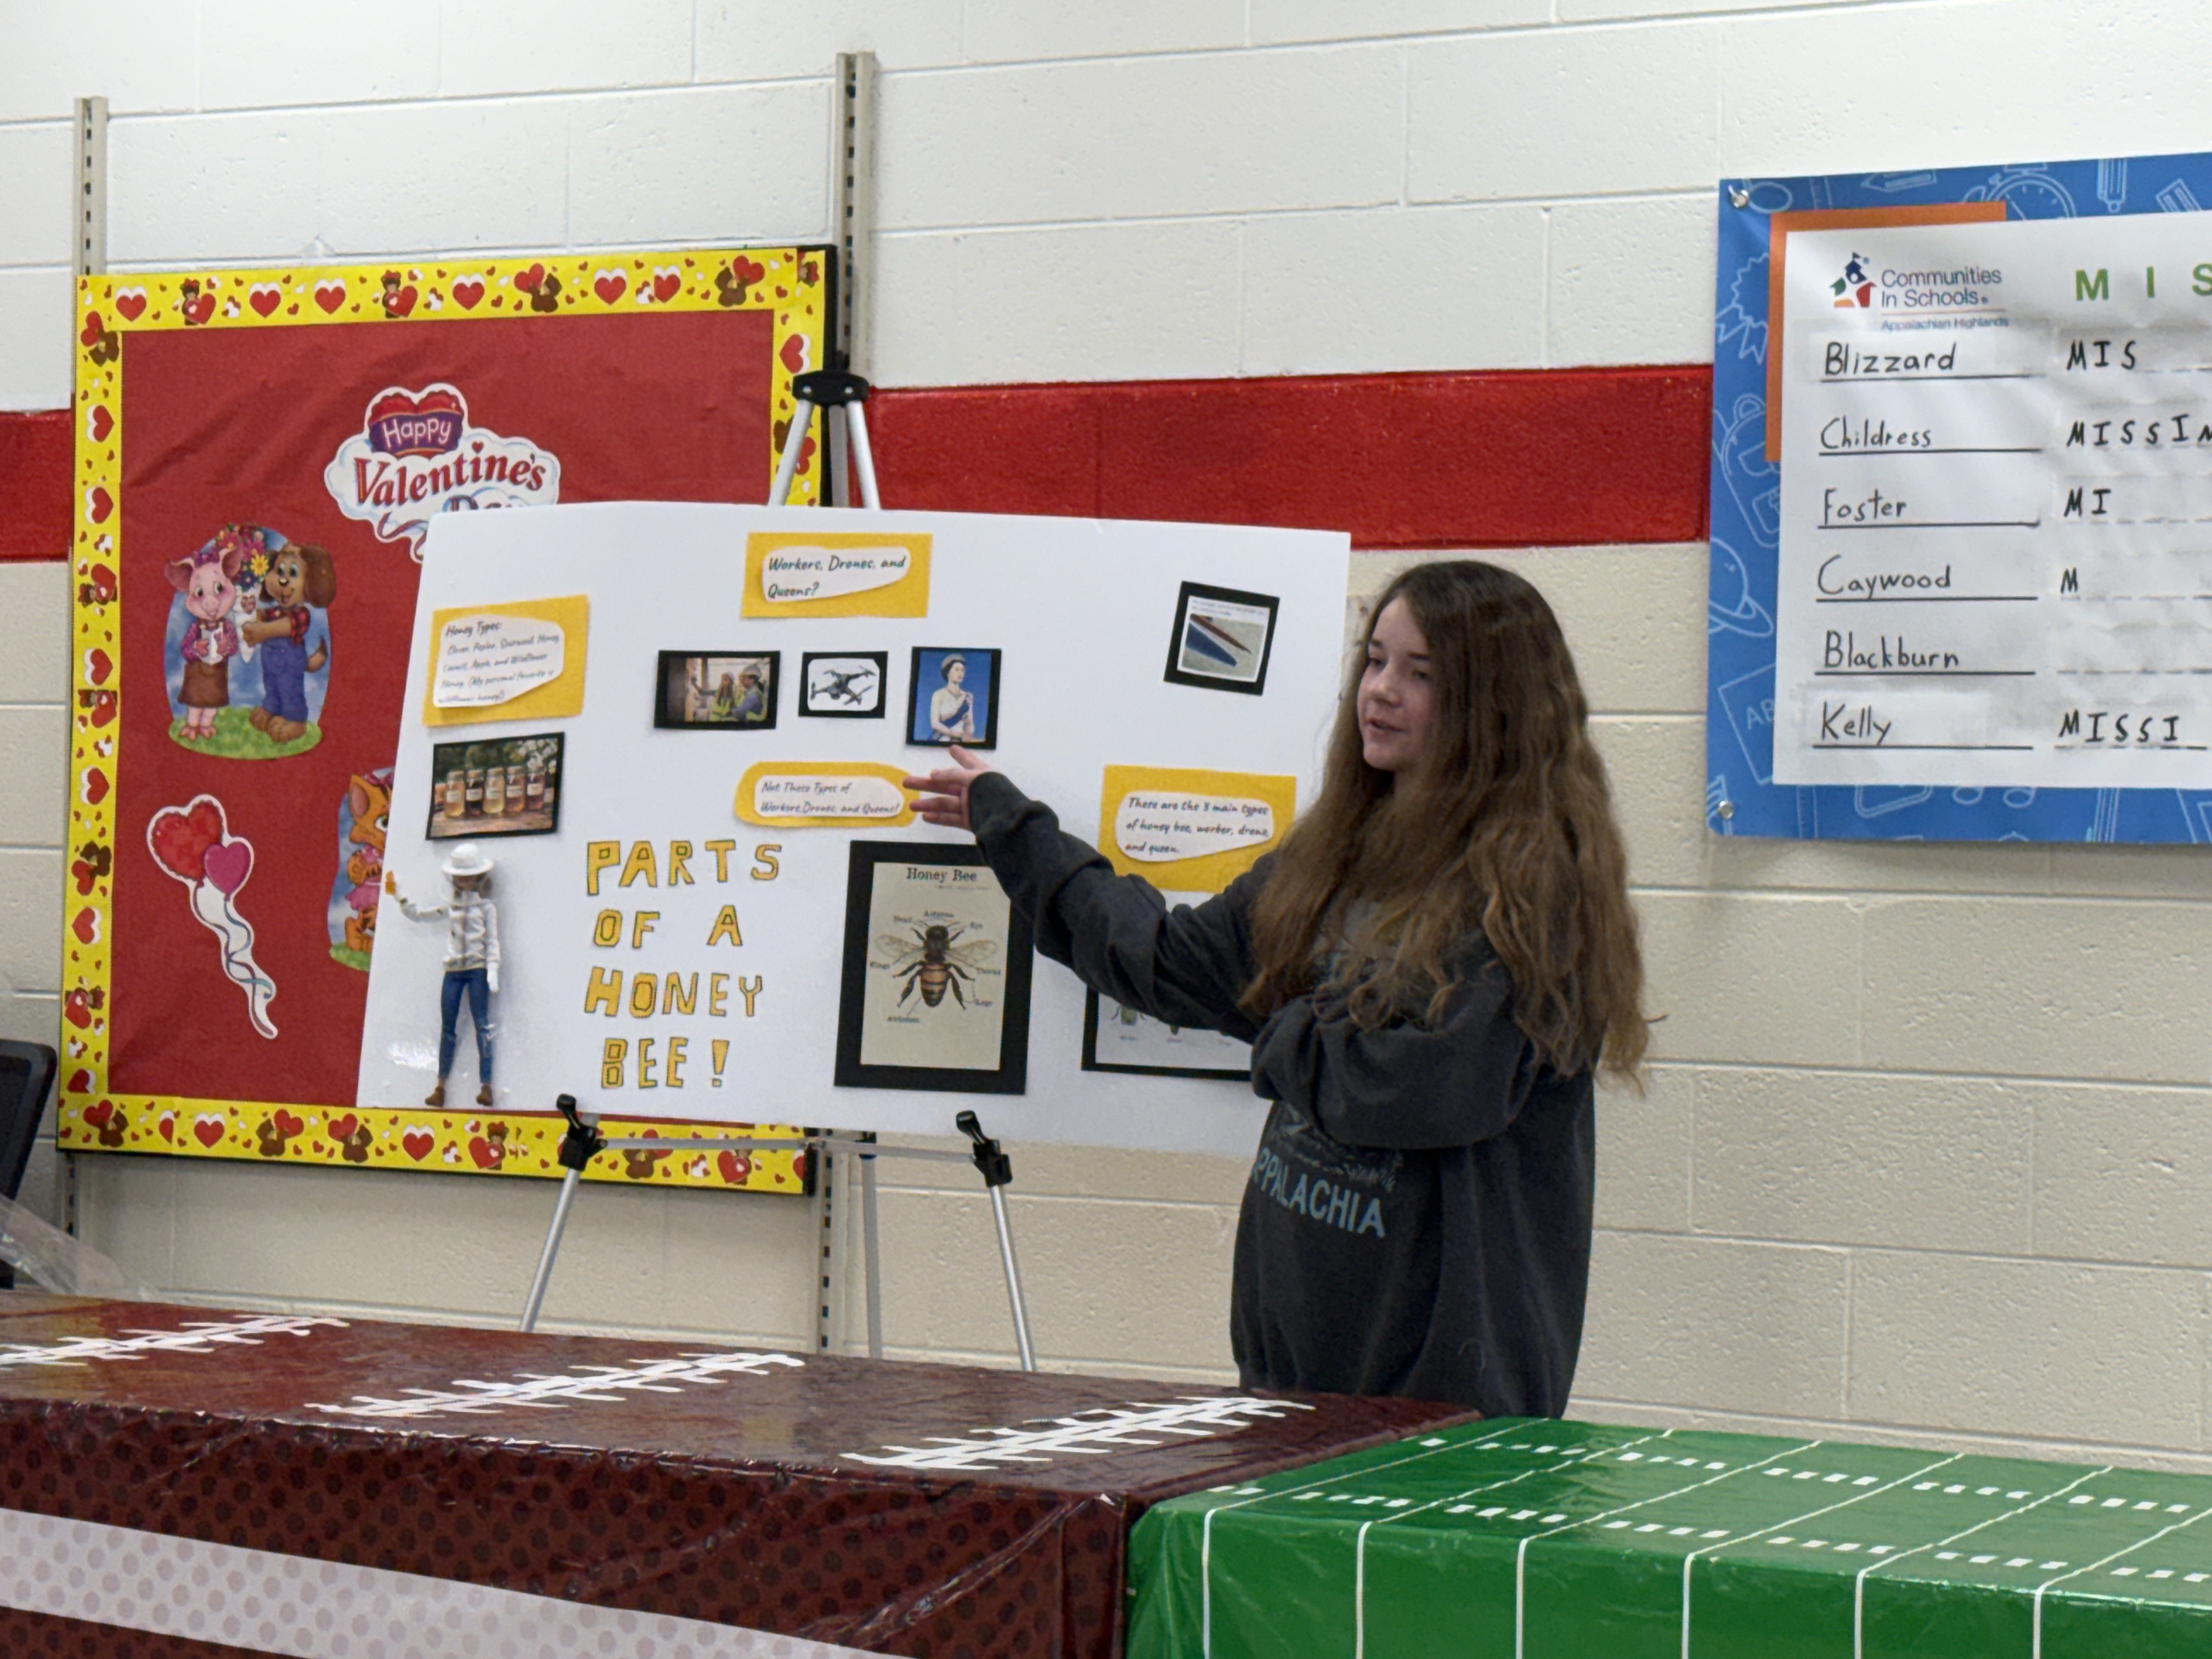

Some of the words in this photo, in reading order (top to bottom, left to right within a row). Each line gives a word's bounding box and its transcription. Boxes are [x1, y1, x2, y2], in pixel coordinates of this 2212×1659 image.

[1881, 266, 2002, 287] Communities
[1882, 291, 1897, 308] In
[1825, 342, 1956, 376] Blizzard
[382, 417, 453, 448] Happy
[1820, 417, 1932, 451] Childress
[354, 441, 546, 507] Valentine's
[1822, 488, 1907, 526] Foster
[2064, 487, 2112, 517] MI
[881, 555, 905, 567] and
[768, 582, 820, 599] Queens?
[1816, 555, 1951, 601] Caywood
[2061, 567, 2078, 594] M
[446, 625, 472, 637] Honey
[1824, 630, 1960, 668] Blackburn
[1821, 701, 1892, 746] Kelly
[841, 782, 851, 793] of
[1161, 802, 1177, 810] are
[1182, 800, 1198, 811] the
[1212, 803, 1237, 811] main
[1127, 819, 1138, 831] of
[1140, 820, 1169, 833] honey
[1126, 840, 1146, 851] and
[586, 839, 782, 896] PARTS
[906, 867, 948, 884] Honey
[953, 868, 977, 882] Bee
[592, 909, 661, 949] OF
[706, 905, 743, 946] A
[584, 966, 763, 1019] HONEY
[1251, 1147, 1385, 1238] PPALACHIA
